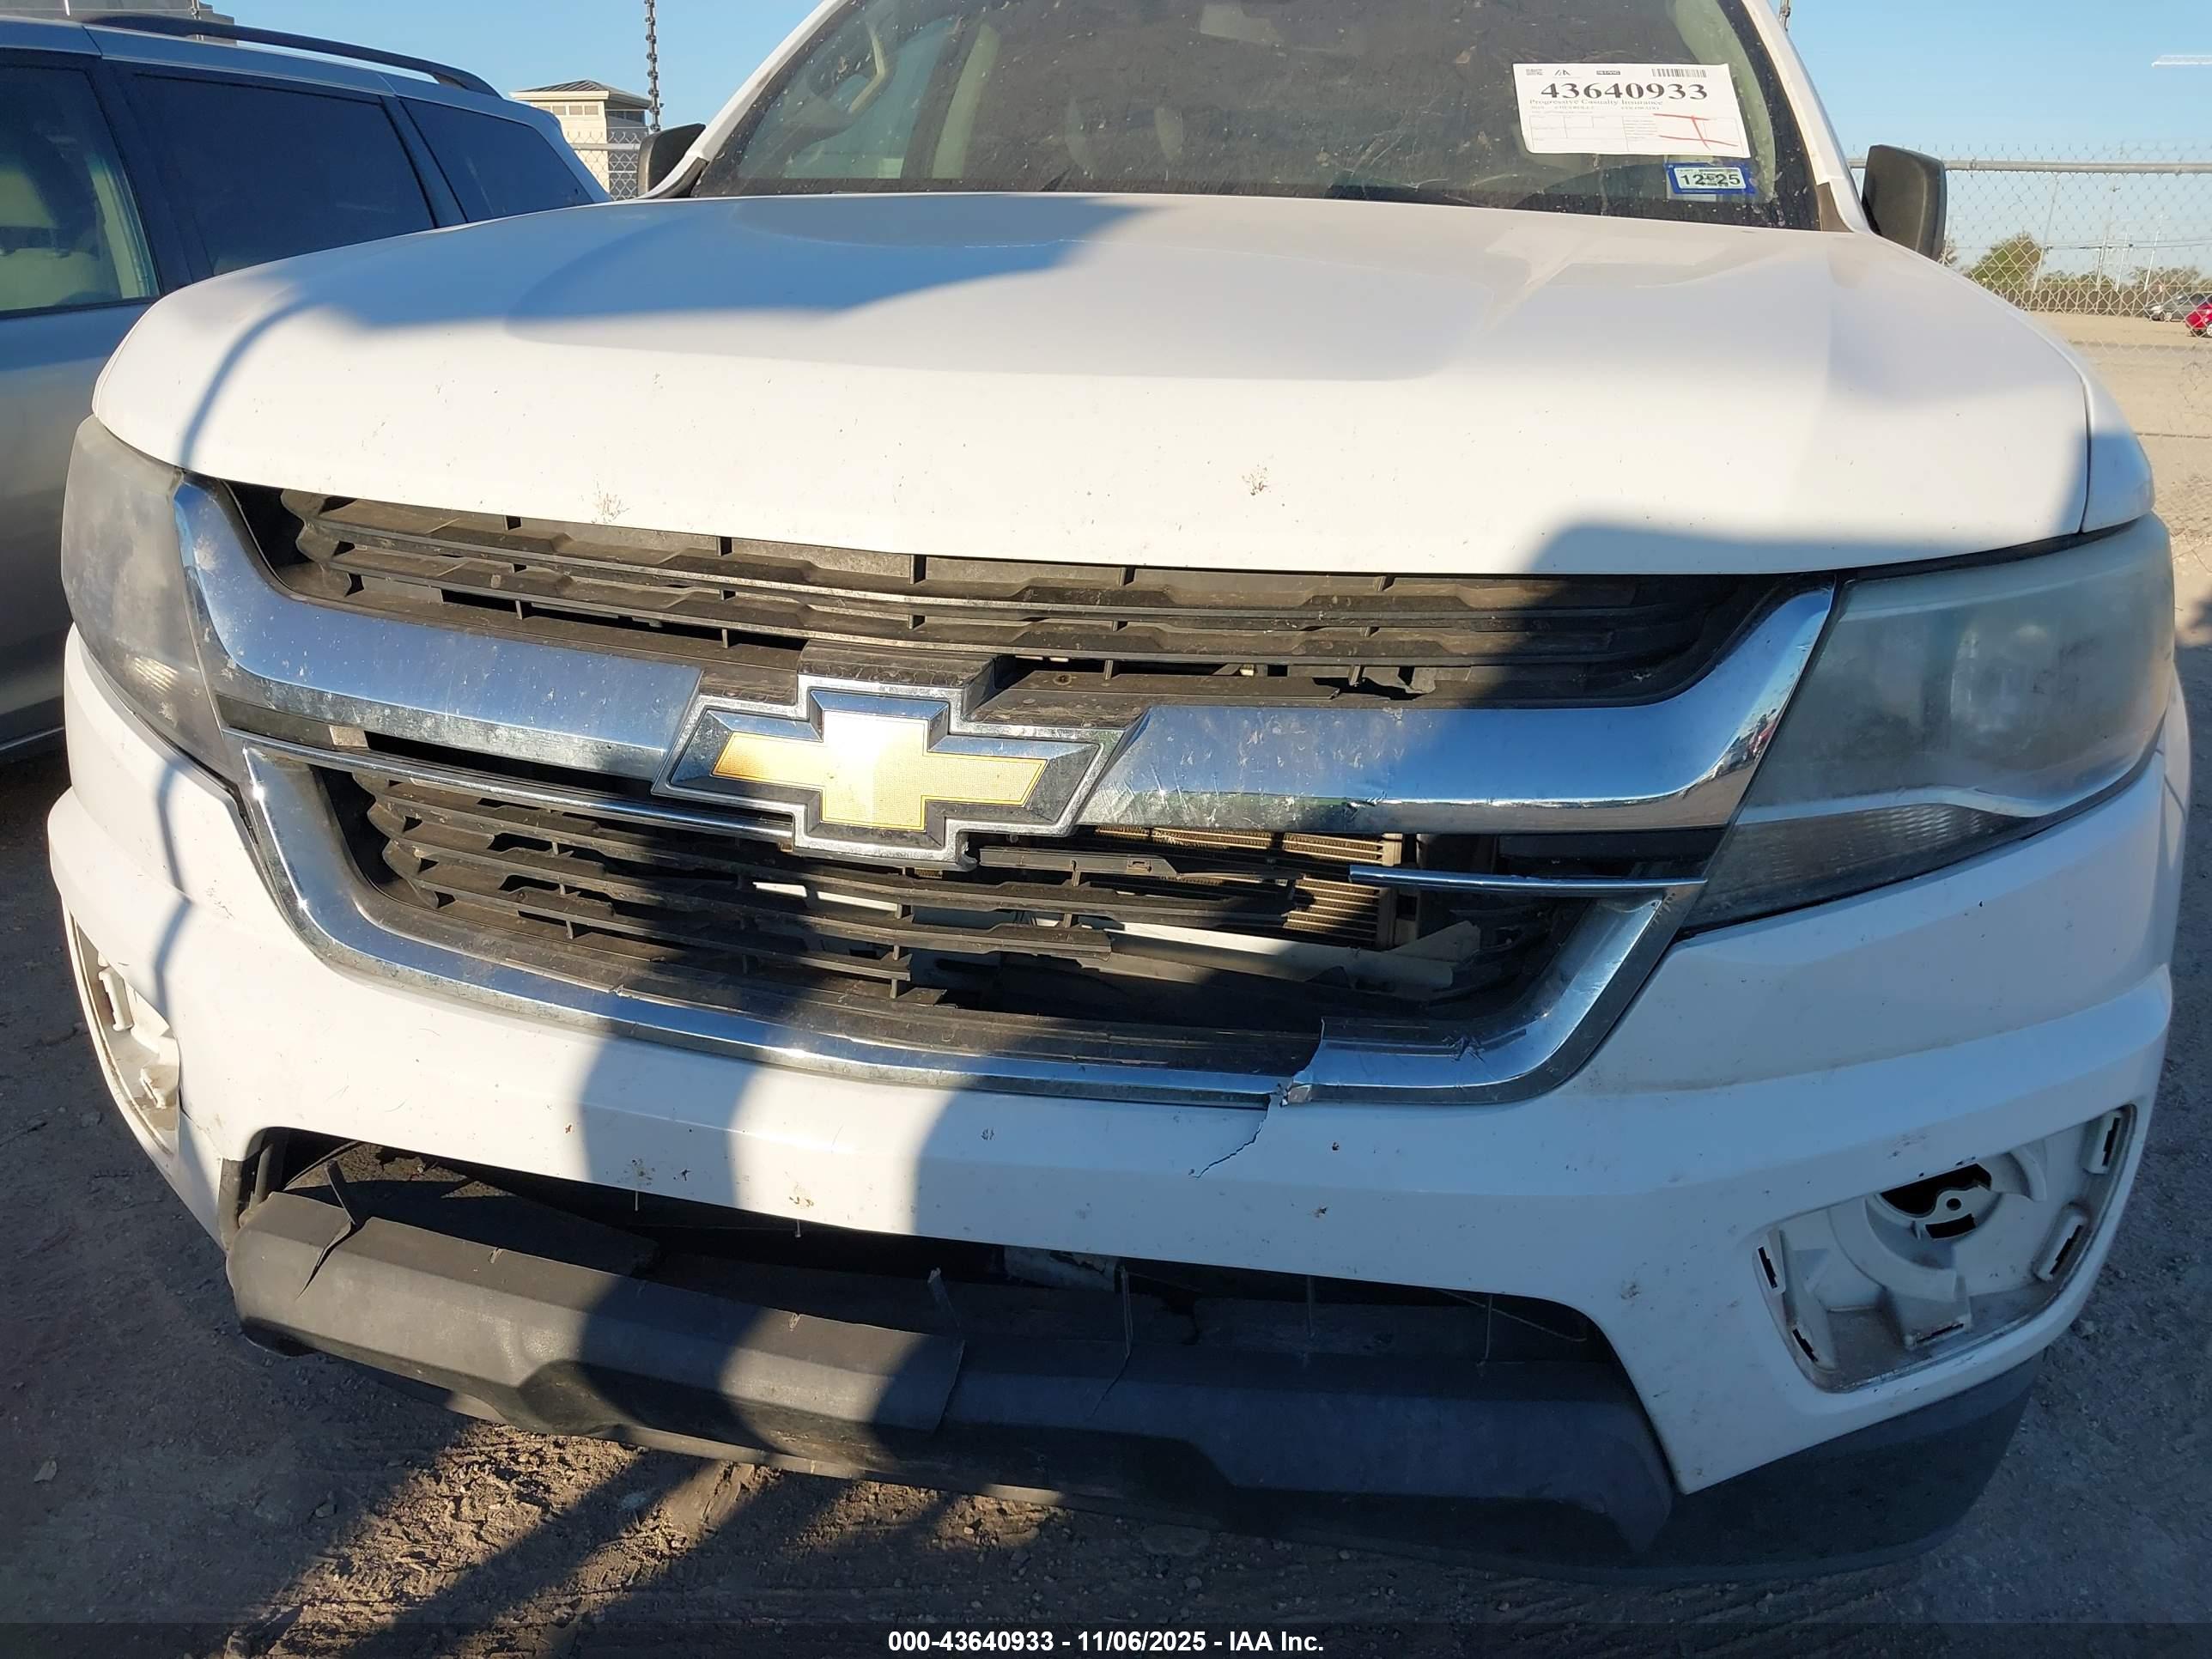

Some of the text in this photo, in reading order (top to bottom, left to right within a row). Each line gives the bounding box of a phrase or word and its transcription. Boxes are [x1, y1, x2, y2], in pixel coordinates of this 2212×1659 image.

[1540, 82, 1708, 100] 43640933
[1680, 173, 1741, 186] 12 25
